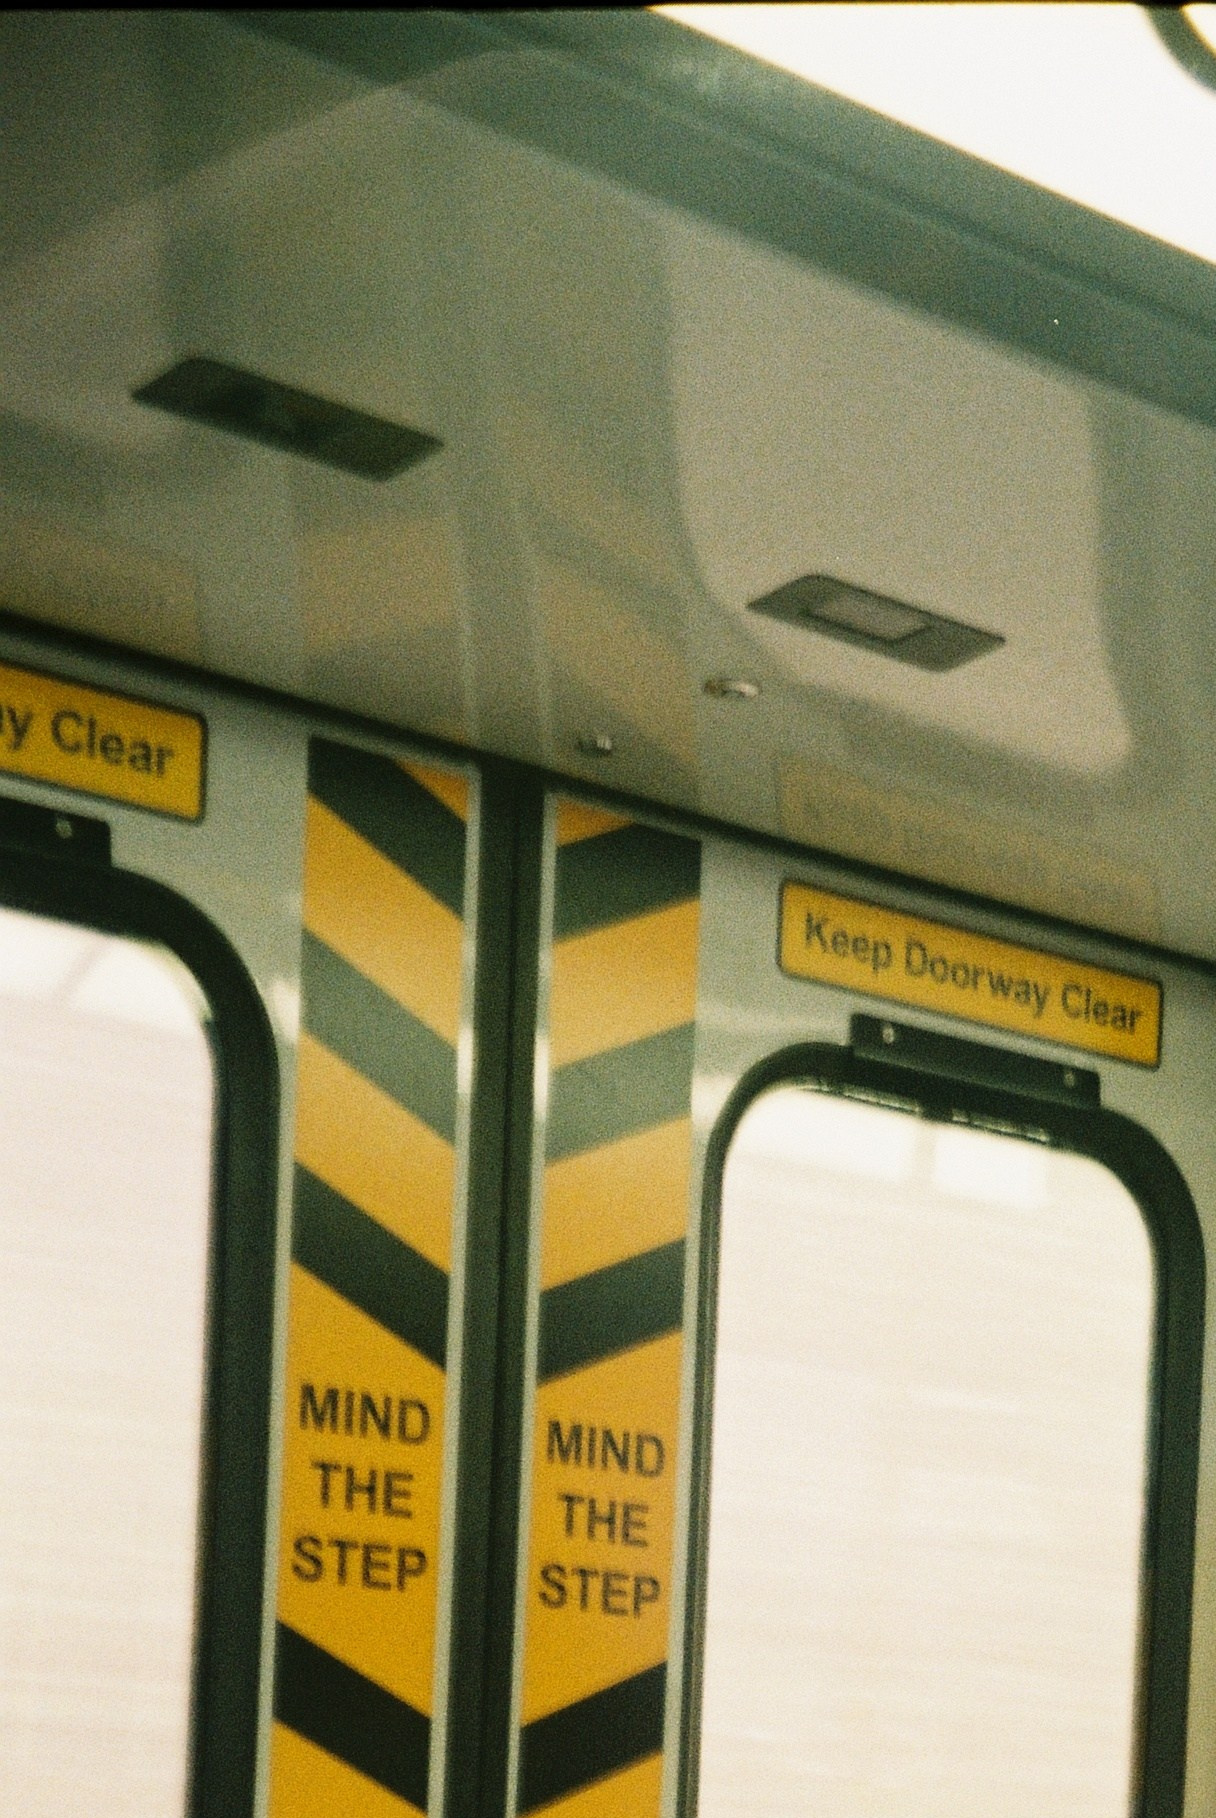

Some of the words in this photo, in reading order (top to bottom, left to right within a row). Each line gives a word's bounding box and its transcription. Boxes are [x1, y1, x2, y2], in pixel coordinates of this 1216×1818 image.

[50, 708, 175, 779] Clear
[804, 911, 893, 976] Keep
[904, 940, 1050, 1020] Doorway
[1061, 983, 1142, 1035] Clear
[299, 1383, 431, 1445] MIND
[546, 1419, 666, 1478] MIND
[311, 1459, 415, 1519] THE
[558, 1493, 650, 1548] THE
[291, 1534, 428, 1592] STEP
[538, 1562, 662, 1619] STEP
